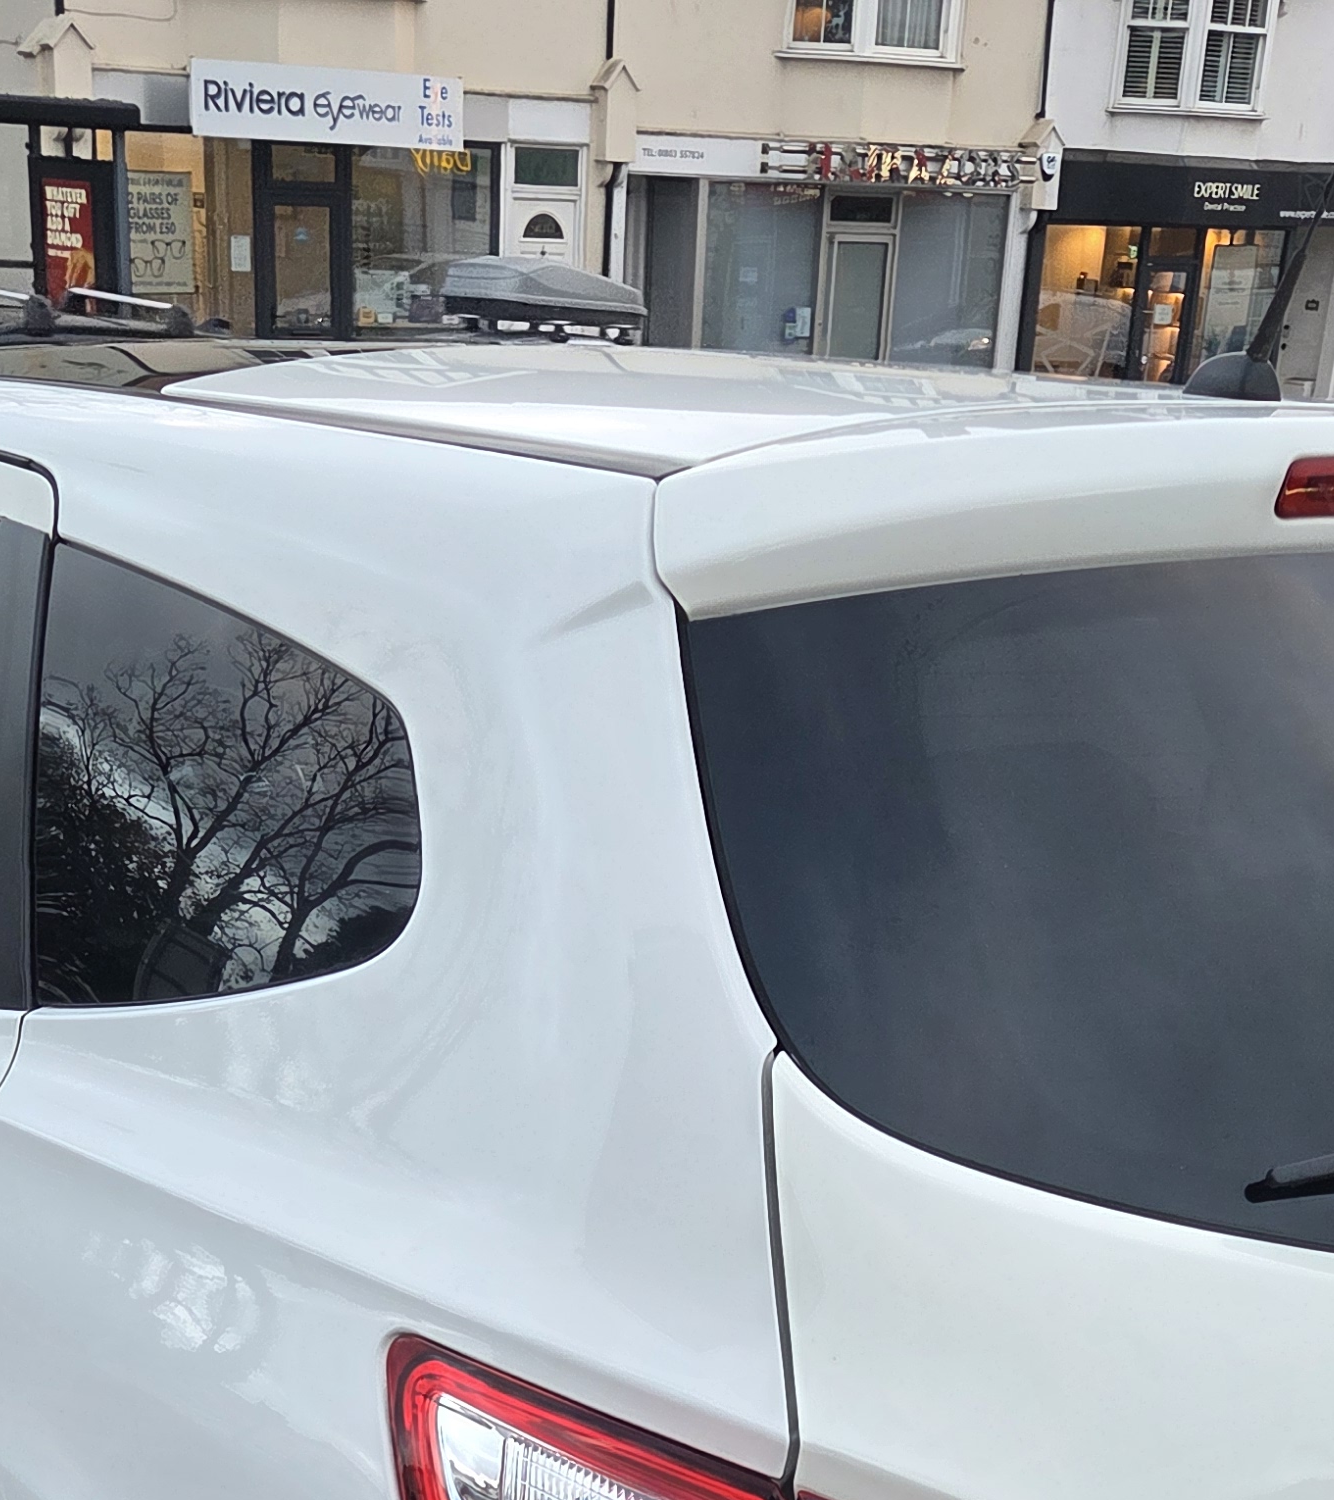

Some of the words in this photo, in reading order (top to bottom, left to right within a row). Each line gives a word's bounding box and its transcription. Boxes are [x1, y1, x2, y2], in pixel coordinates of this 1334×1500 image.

[203, 79, 306, 118] Riviera
[313, 91, 402, 131] eyewear
[418, 106, 453, 129] Tests
[418, 134, 453, 147] Avaable
[1194, 181, 1230, 198] EXPERT
[1230, 183, 1261, 200] SMILE
[137, 191, 164, 206] PAIRS
[166, 192, 180, 206] OF
[128, 206, 172, 220] GLASSES
[129, 220, 158, 235] FROM
